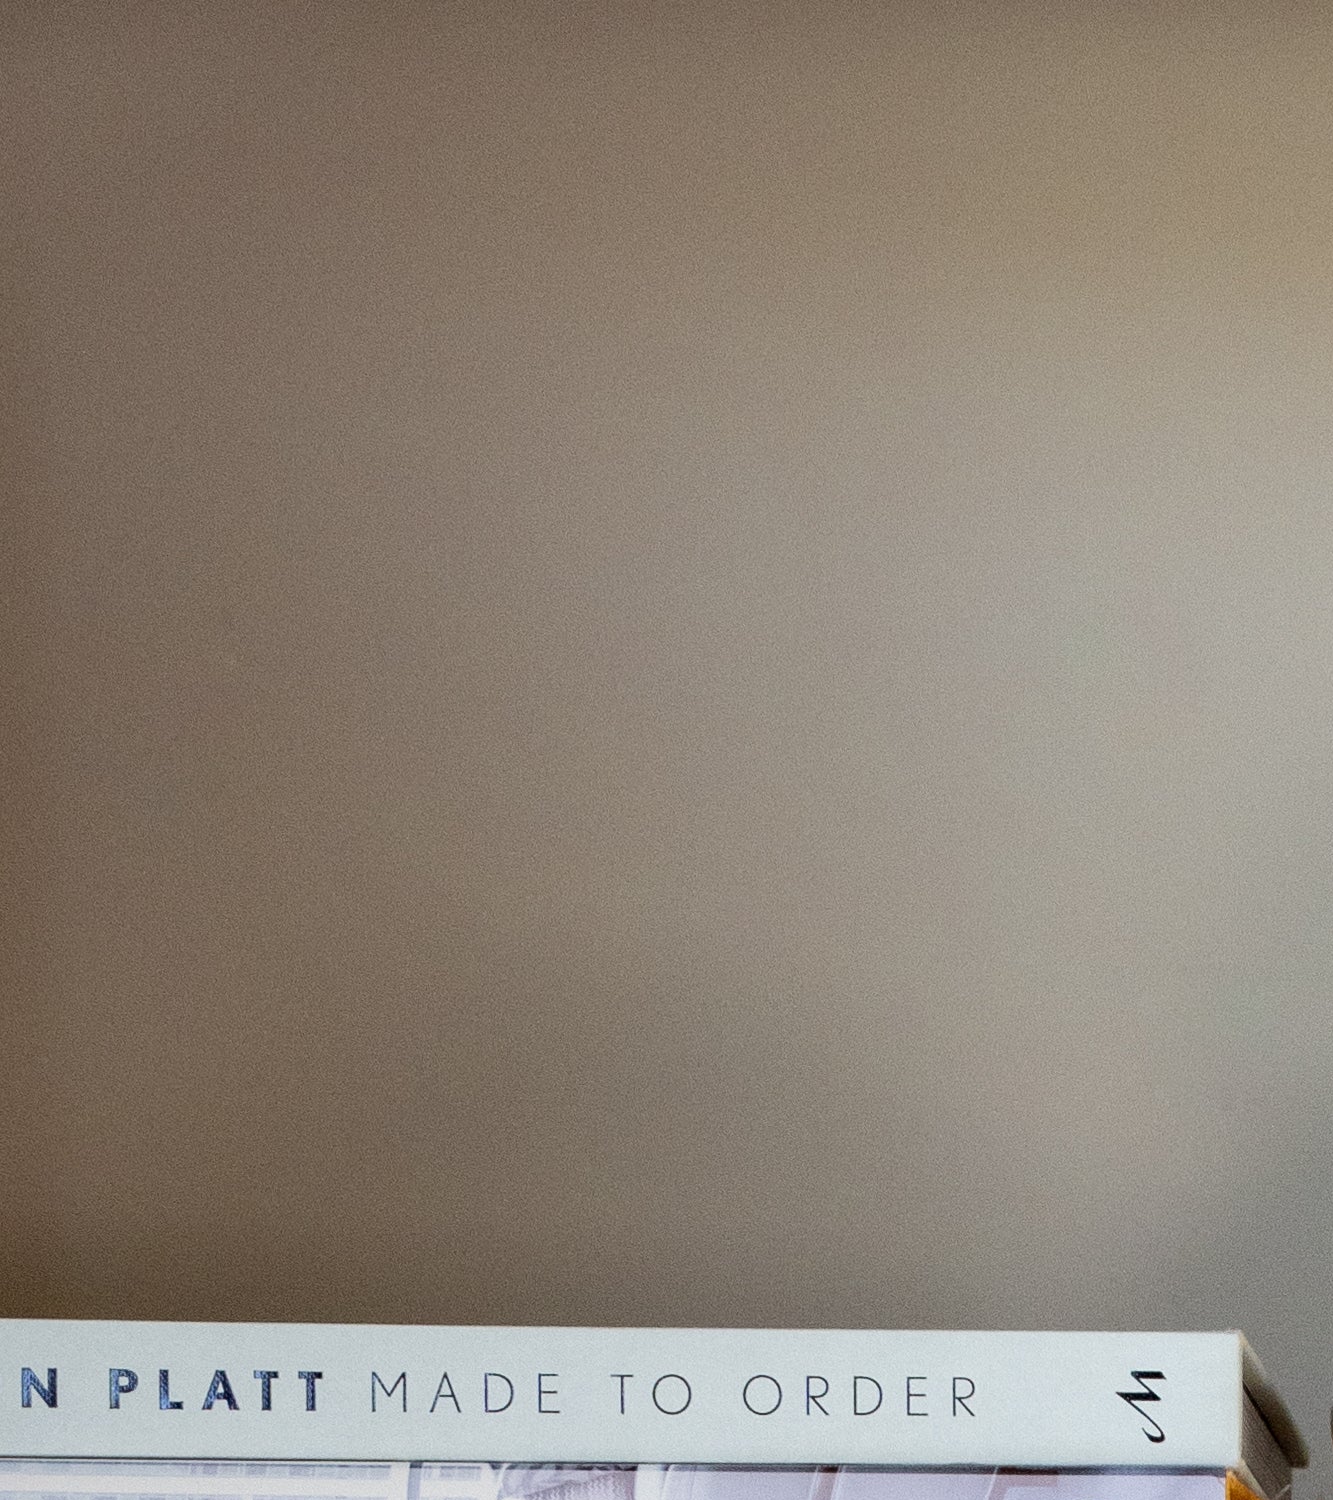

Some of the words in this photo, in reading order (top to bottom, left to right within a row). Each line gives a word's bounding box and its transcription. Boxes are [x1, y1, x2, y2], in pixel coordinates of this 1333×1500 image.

[20, 1367, 58, 1409] N
[108, 1368, 324, 1412] PLATT
[371, 1371, 561, 1415] MADE
[610, 1373, 693, 1416] TO
[742, 1374, 977, 1418] ORDER
